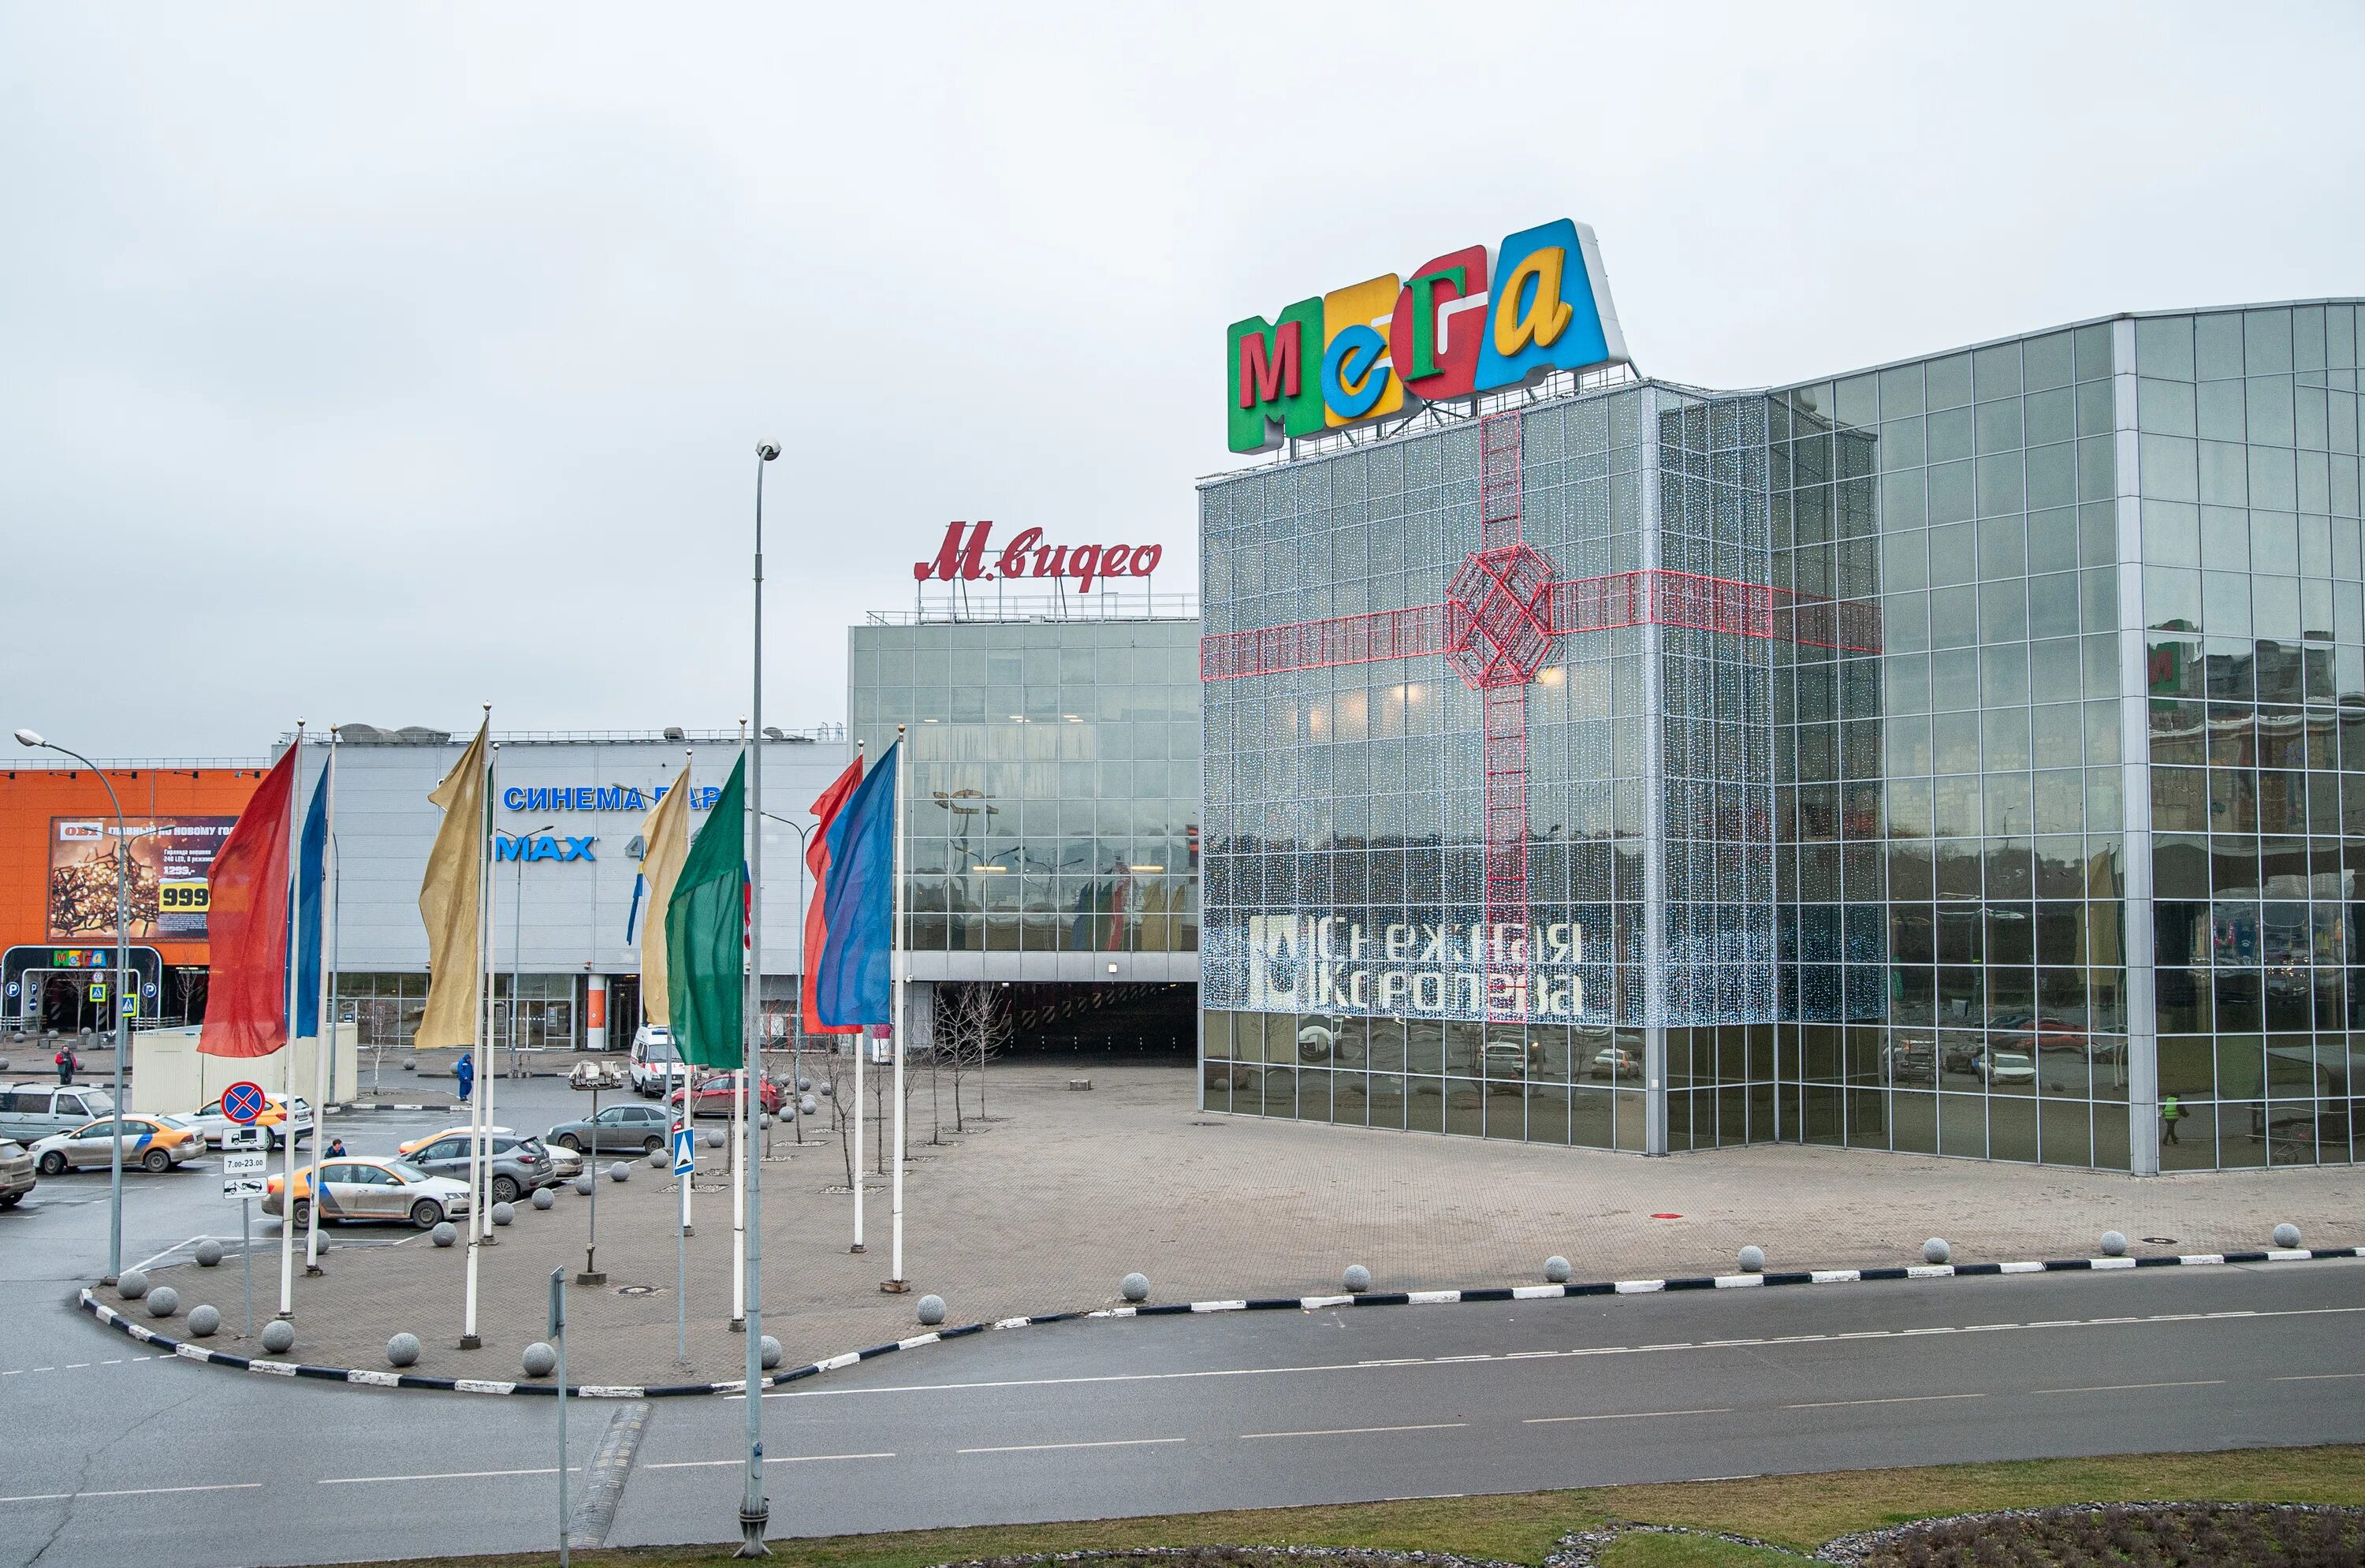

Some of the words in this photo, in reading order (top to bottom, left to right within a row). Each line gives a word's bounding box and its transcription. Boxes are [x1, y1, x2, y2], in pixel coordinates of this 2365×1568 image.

[914, 520, 1162, 594] М.видео
[503, 787, 645, 810] СИНЕМА
[65, 827, 99, 836] OBI
[108, 825, 157, 836] ГЛАВНЫЙ
[173, 827, 216, 836] НОВОМУ
[495, 836, 596, 861] MAX
[163, 888, 209, 906] 999
[227, 1159, 263, 1168] 7.00-23.00
